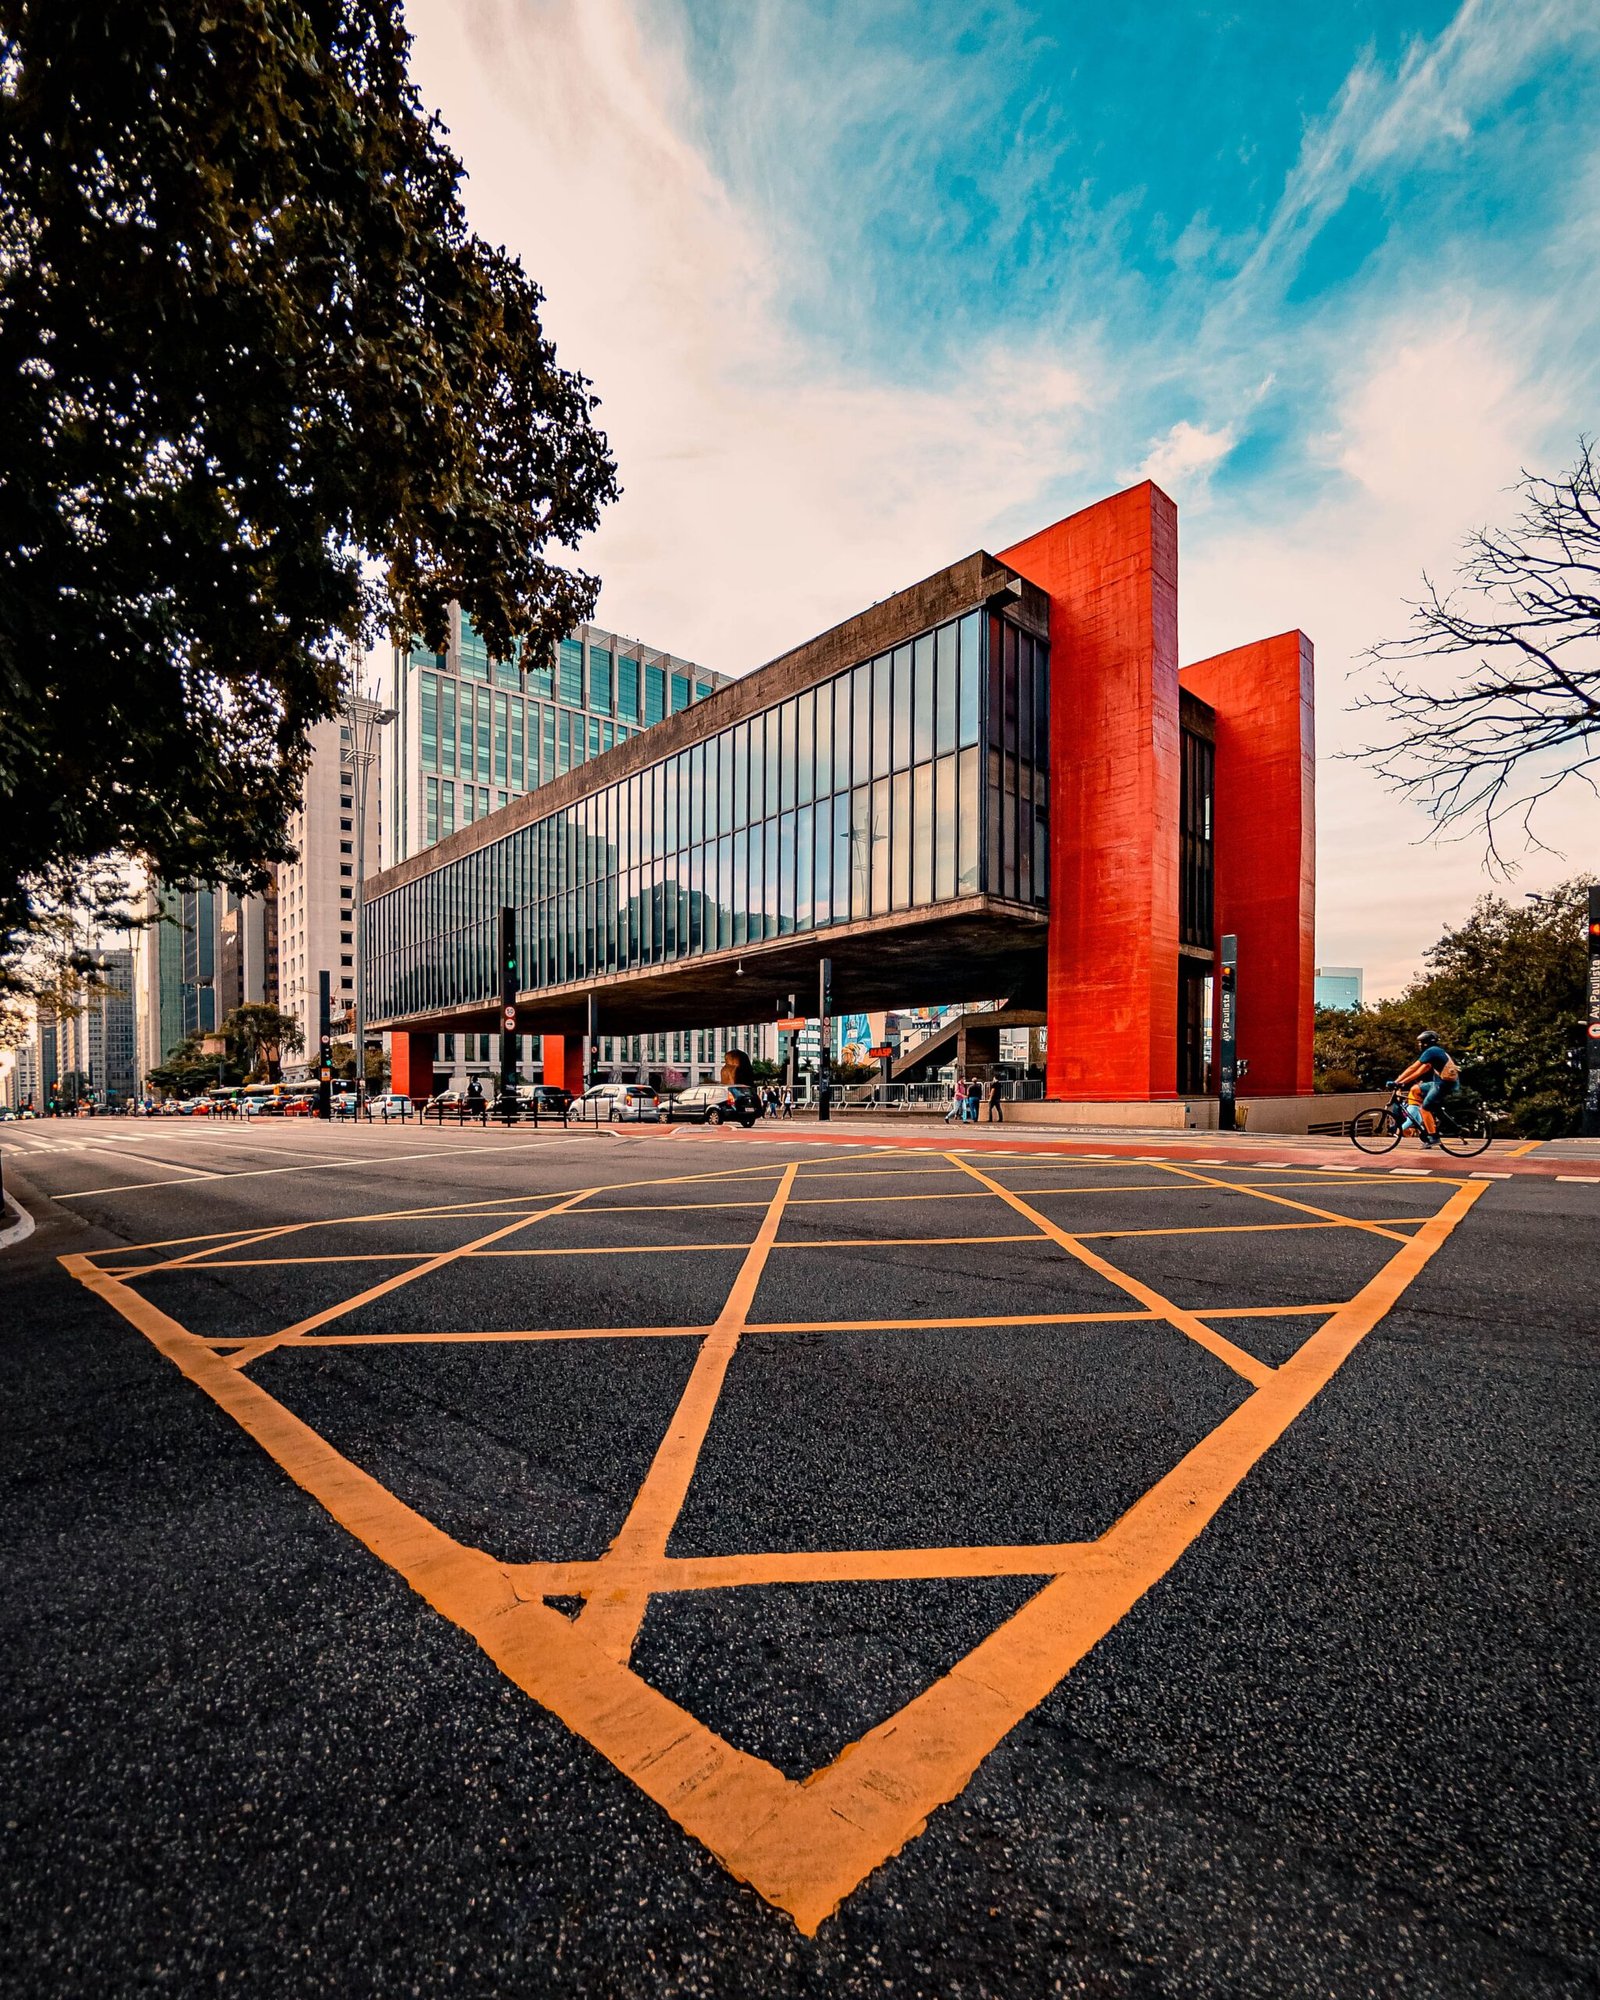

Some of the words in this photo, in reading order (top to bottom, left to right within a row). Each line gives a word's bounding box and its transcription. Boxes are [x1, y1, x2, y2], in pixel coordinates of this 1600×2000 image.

[1588, 959, 1600, 1003] Paulista
[1222, 994, 1230, 1029] Paulista
[870, 1048, 892, 1057] MASP
